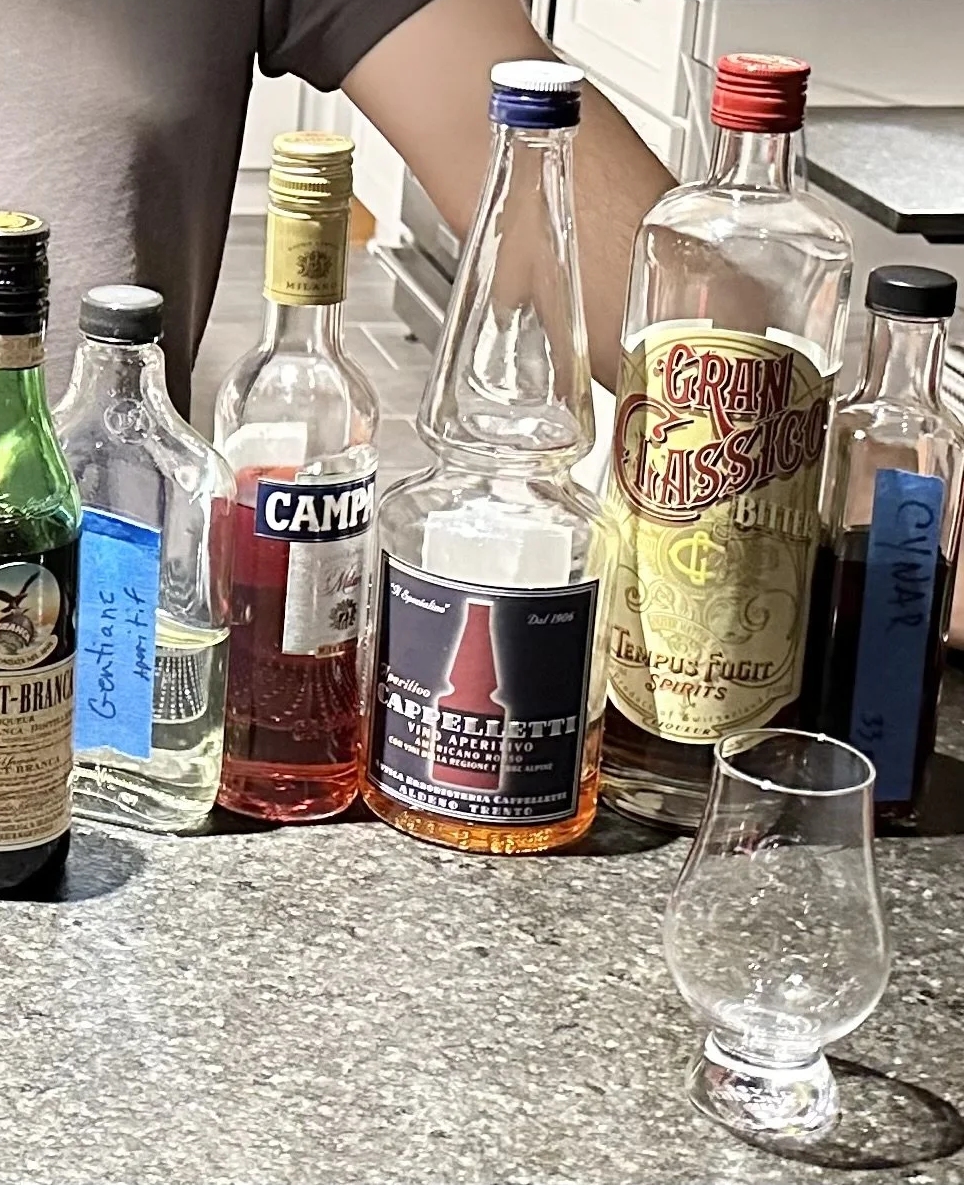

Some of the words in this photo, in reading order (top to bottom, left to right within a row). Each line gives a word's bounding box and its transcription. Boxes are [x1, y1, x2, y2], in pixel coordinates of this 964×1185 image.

[653, 343, 795, 442] GRAN
[614, 392, 829, 523] CLASSICO
[873, 499, 935, 631] CYNAR
[88, 589, 117, 720] Gentiane
[612, 624, 700, 679] TEMPUS
[705, 651, 774, 684] FUGIT
[378, 681, 577, 739] CAPPELLETTI
[644, 672, 729, 708] SPIRITS
[407, 721, 442, 742] VINO
[447, 735, 534, 753] APERITIVO
[413, 737, 480, 761] AMERICANO
[485, 752, 523, 764] ROSSO
[15, 756, 61, 774] BRANCA
[448, 757, 488, 771] REGIONE
[398, 784, 460, 810] ALDENO
[468, 803, 534, 817] TRENTO
